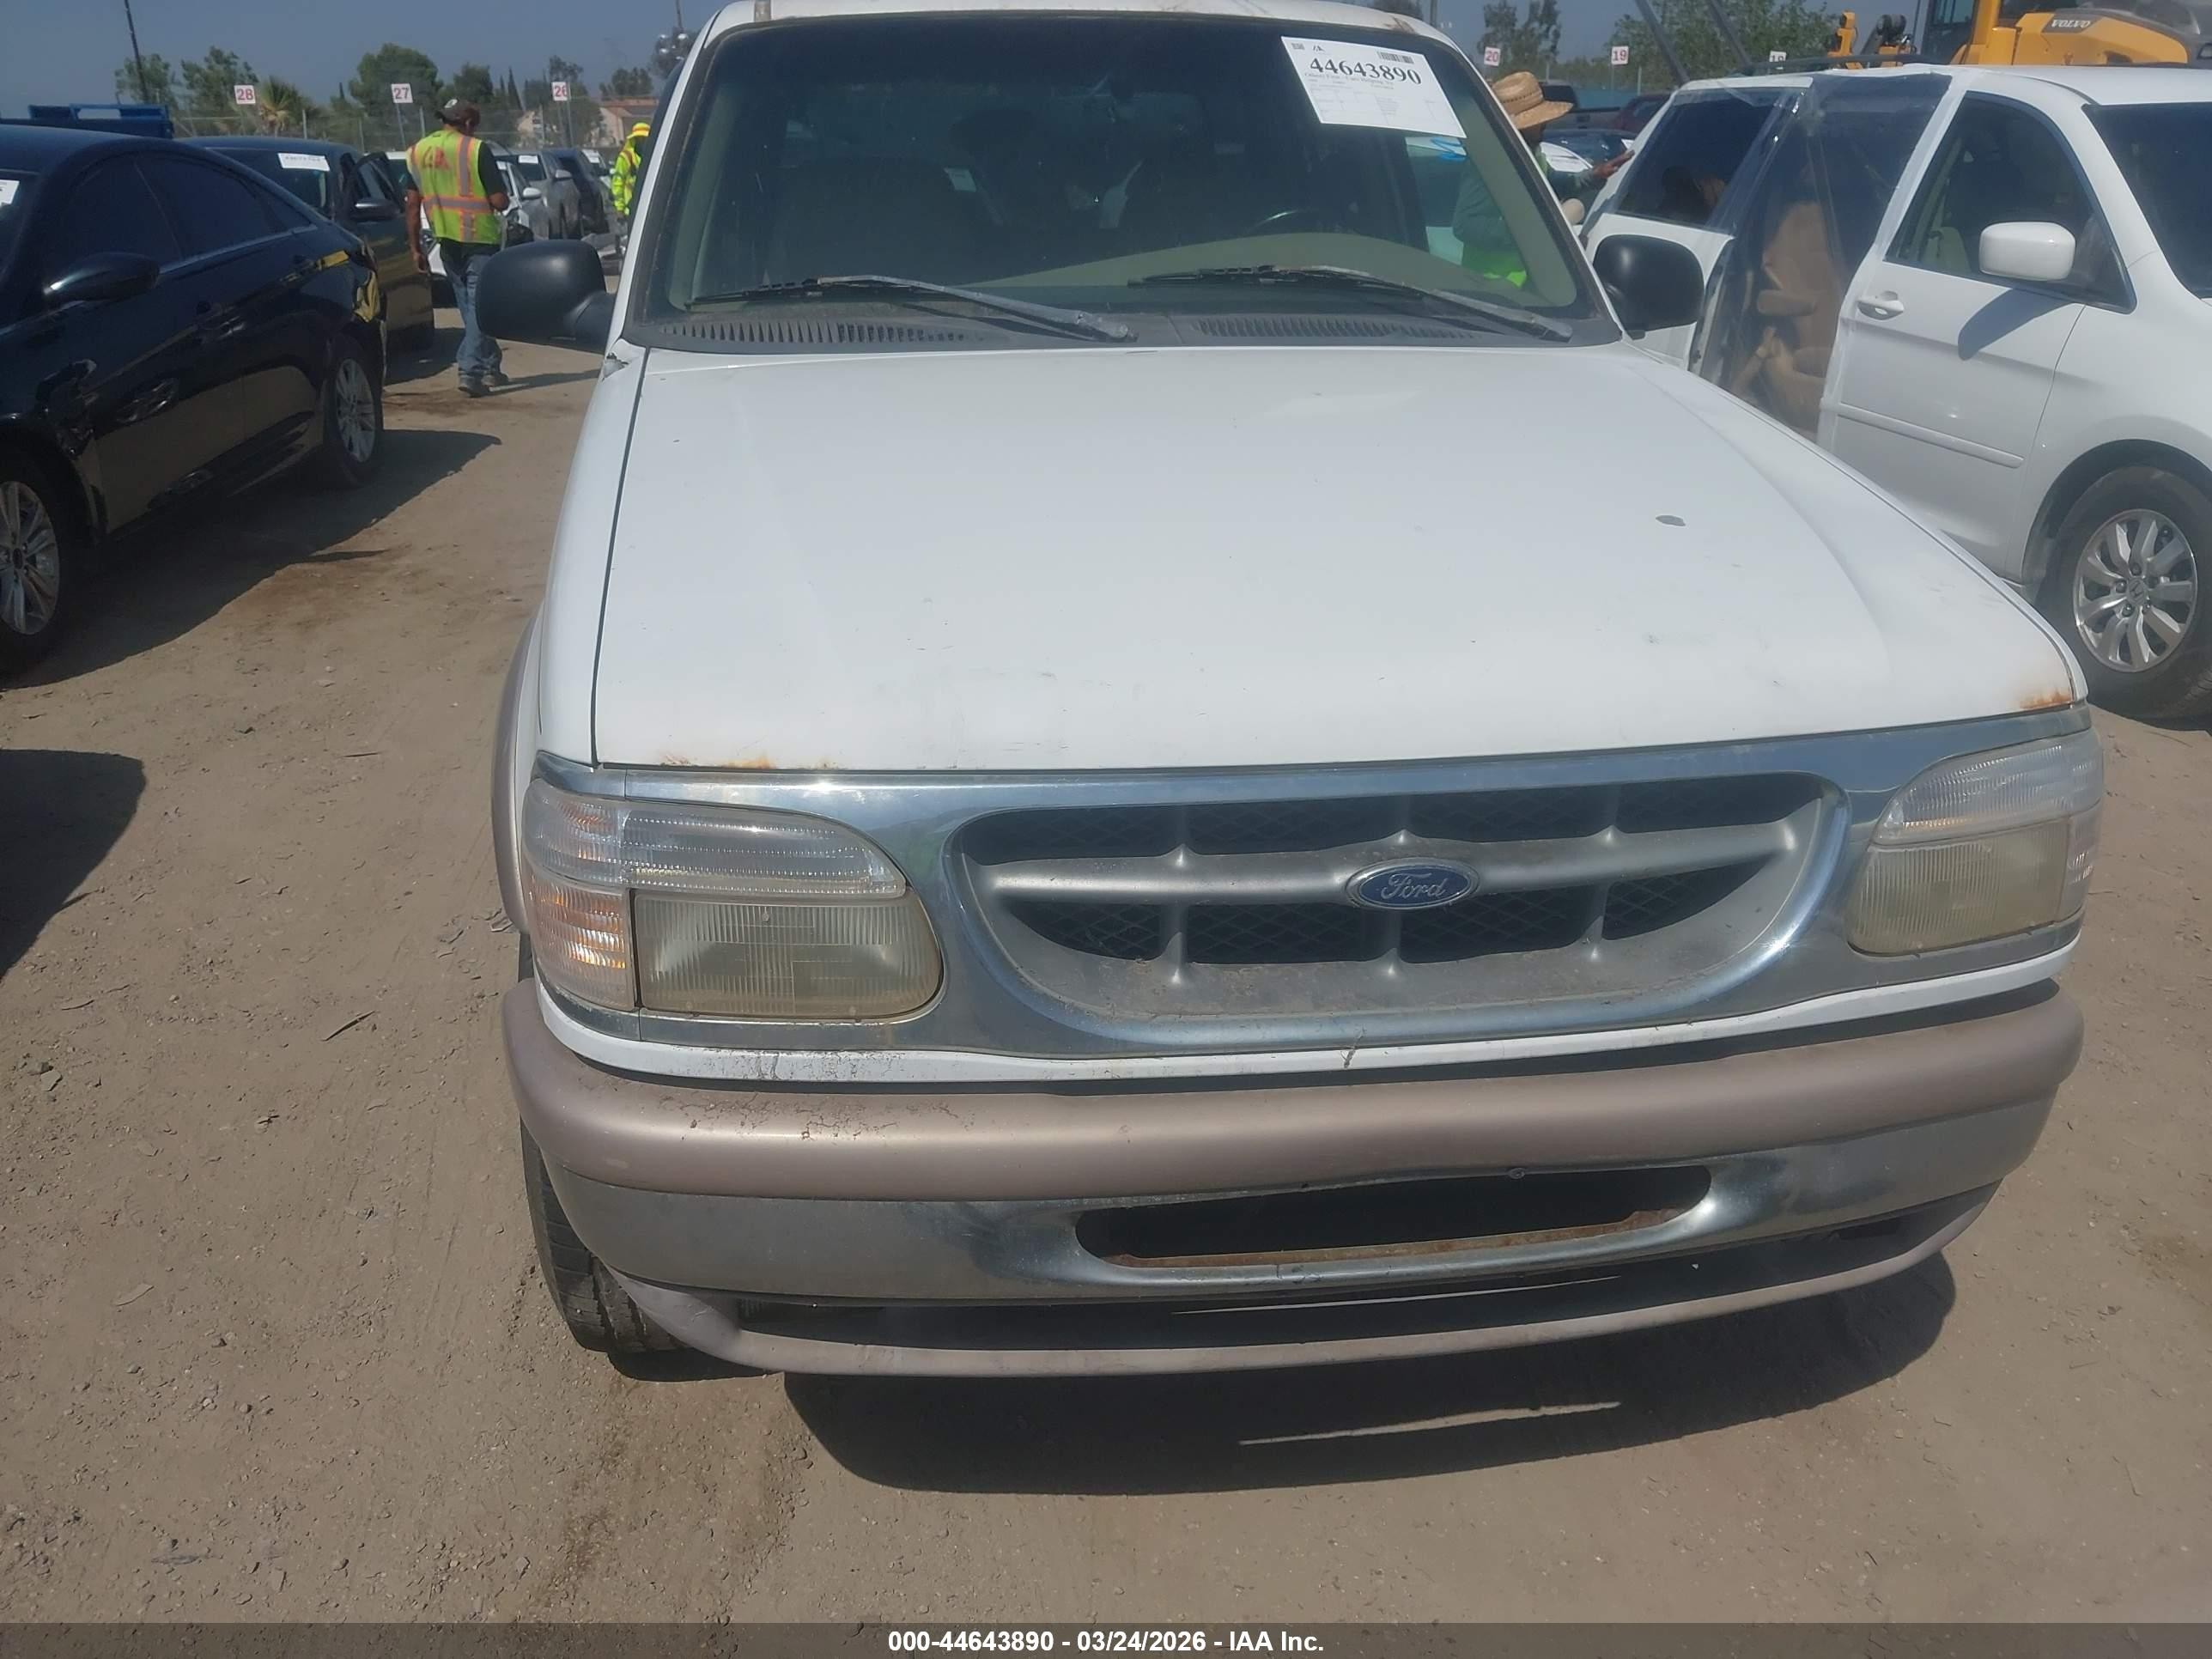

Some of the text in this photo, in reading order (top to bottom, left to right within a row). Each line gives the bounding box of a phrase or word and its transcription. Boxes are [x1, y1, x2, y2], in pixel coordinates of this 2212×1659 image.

[2051, 19, 2091, 28] VOLVO
[1486, 50, 1498, 63] 20
[1613, 49, 1627, 61] 19
[1310, 58, 1422, 84] 44643890
[237, 88, 254, 100] 28
[393, 87, 410, 100] 27
[1380, 872, 1448, 900] Ford
